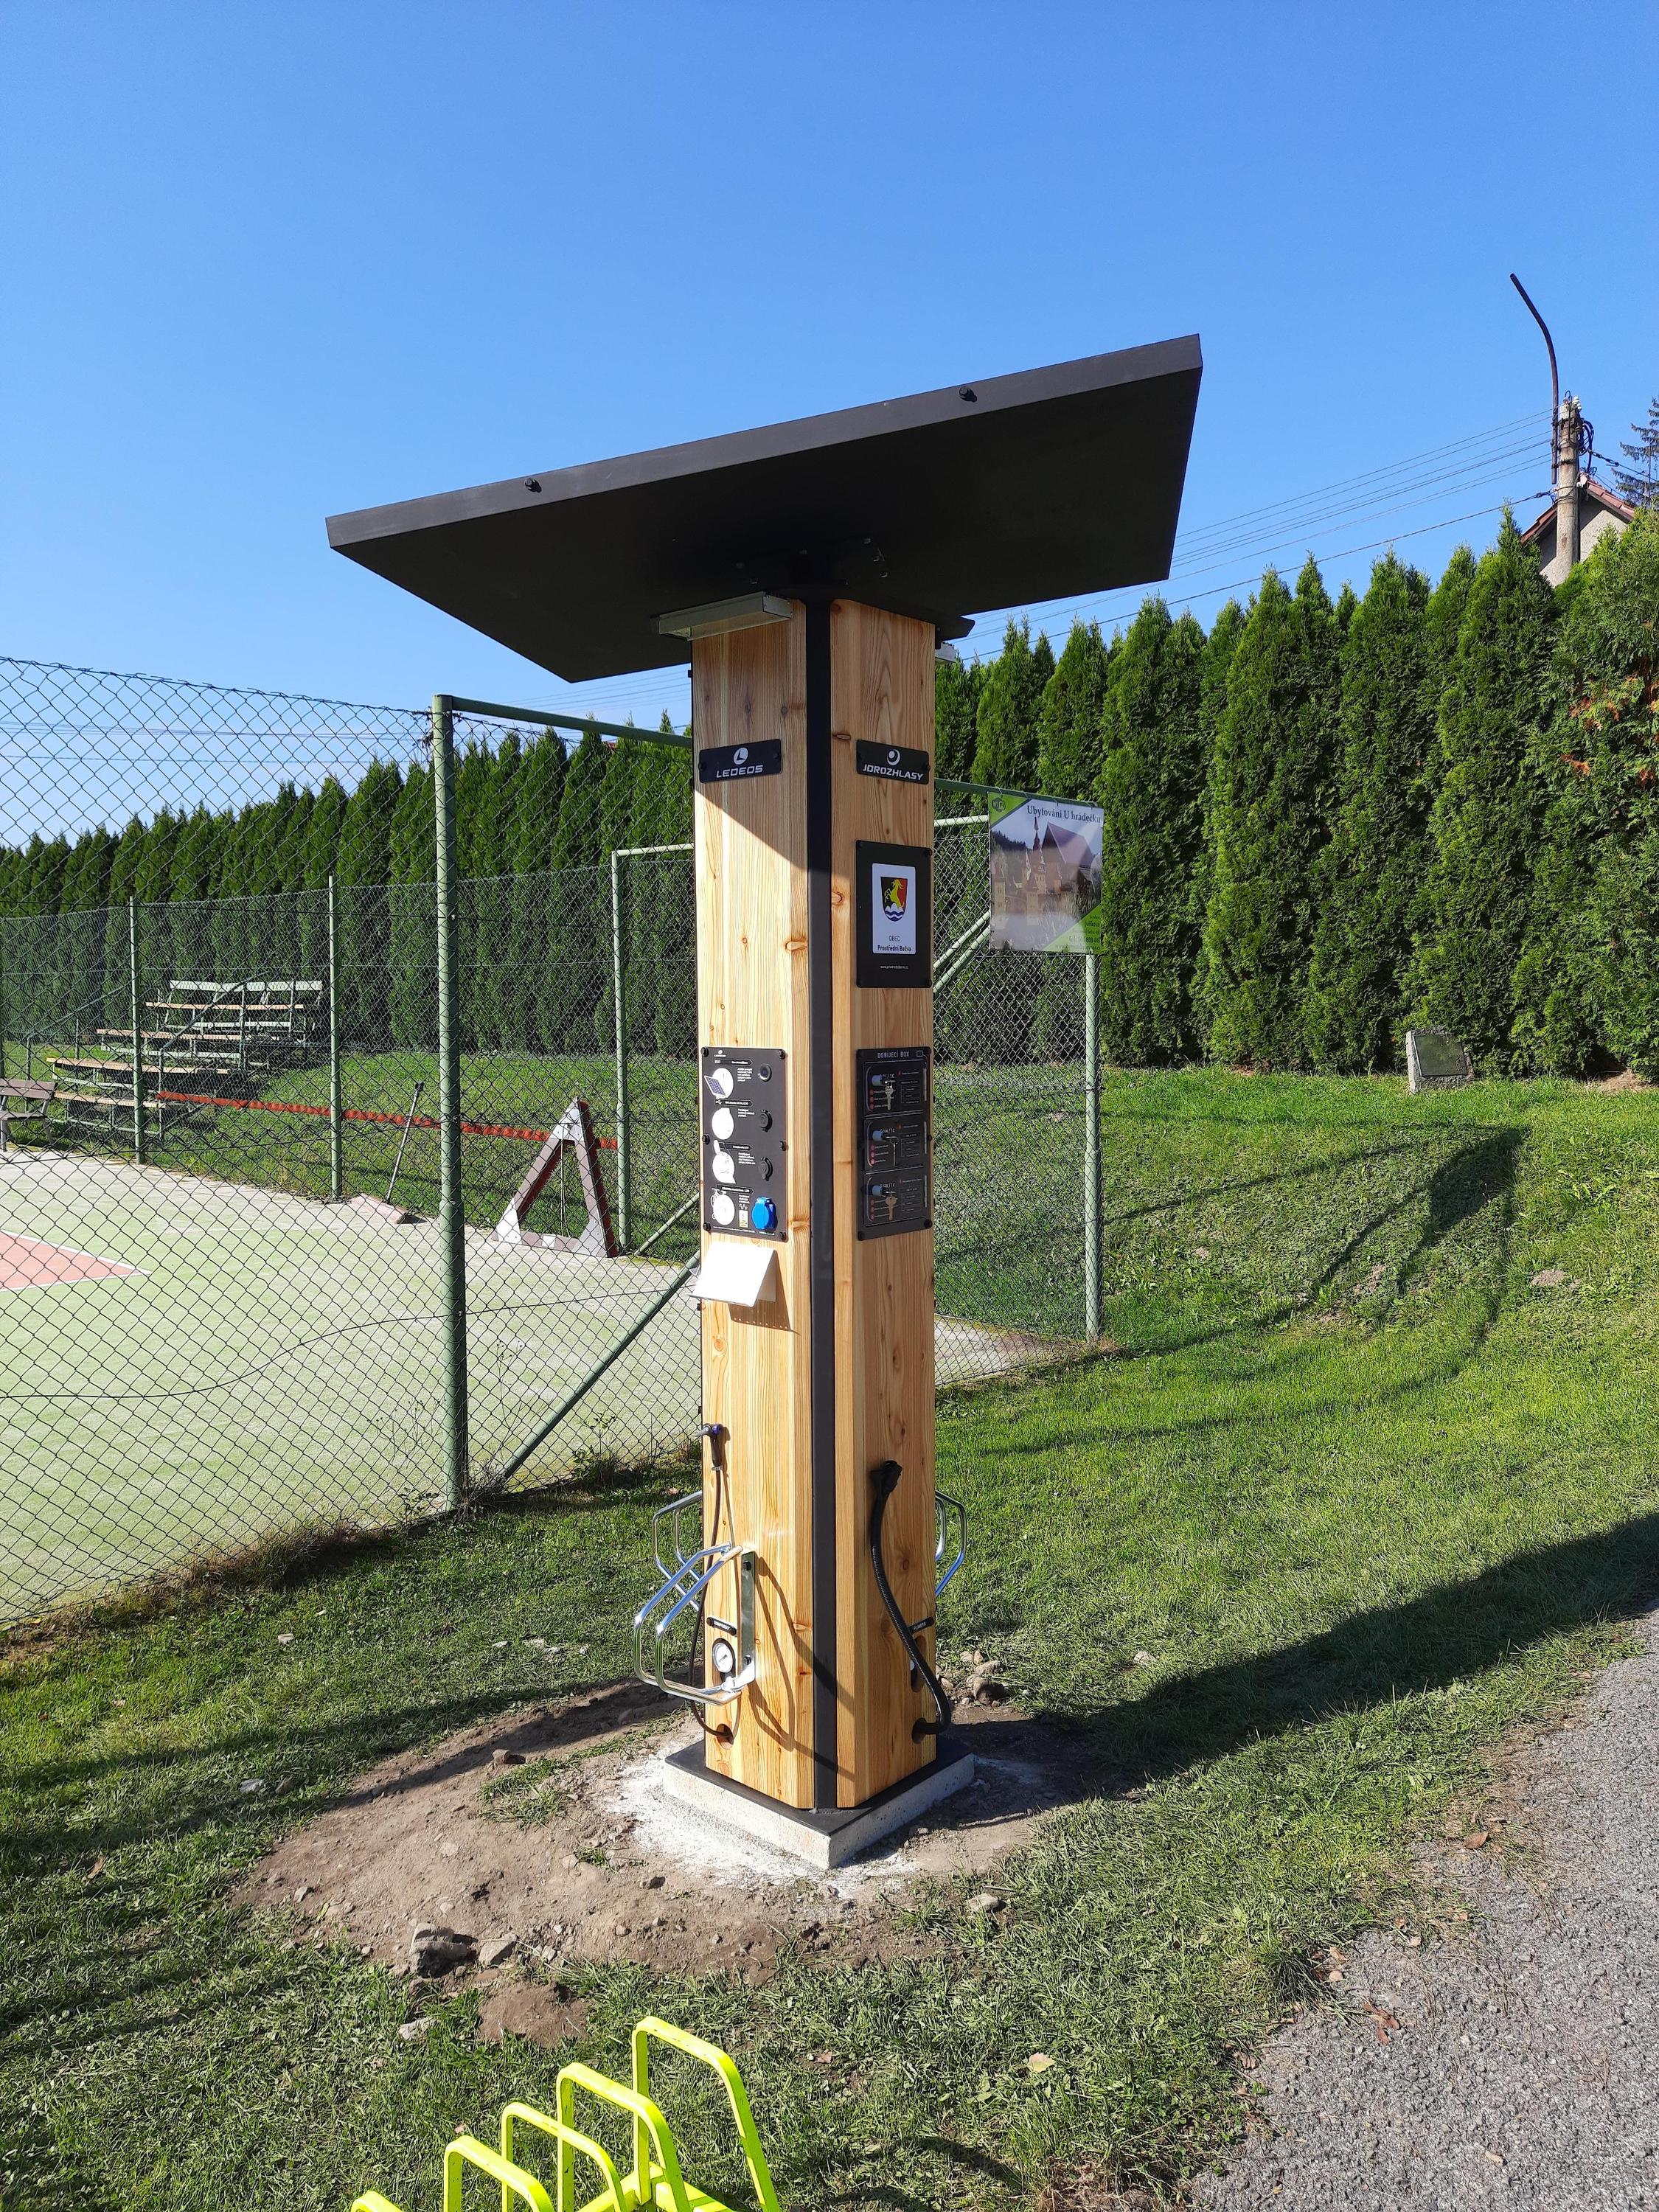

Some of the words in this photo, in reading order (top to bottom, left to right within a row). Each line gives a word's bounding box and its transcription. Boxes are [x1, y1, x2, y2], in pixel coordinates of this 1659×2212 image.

[716, 765, 764, 778] LEDEOS
[863, 764, 924, 780] JOROZHLASY
[1027, 805, 1062, 818] Ubytování
[1064, 810, 1070, 819] U
[1071, 811, 1101, 824] hrádečku
